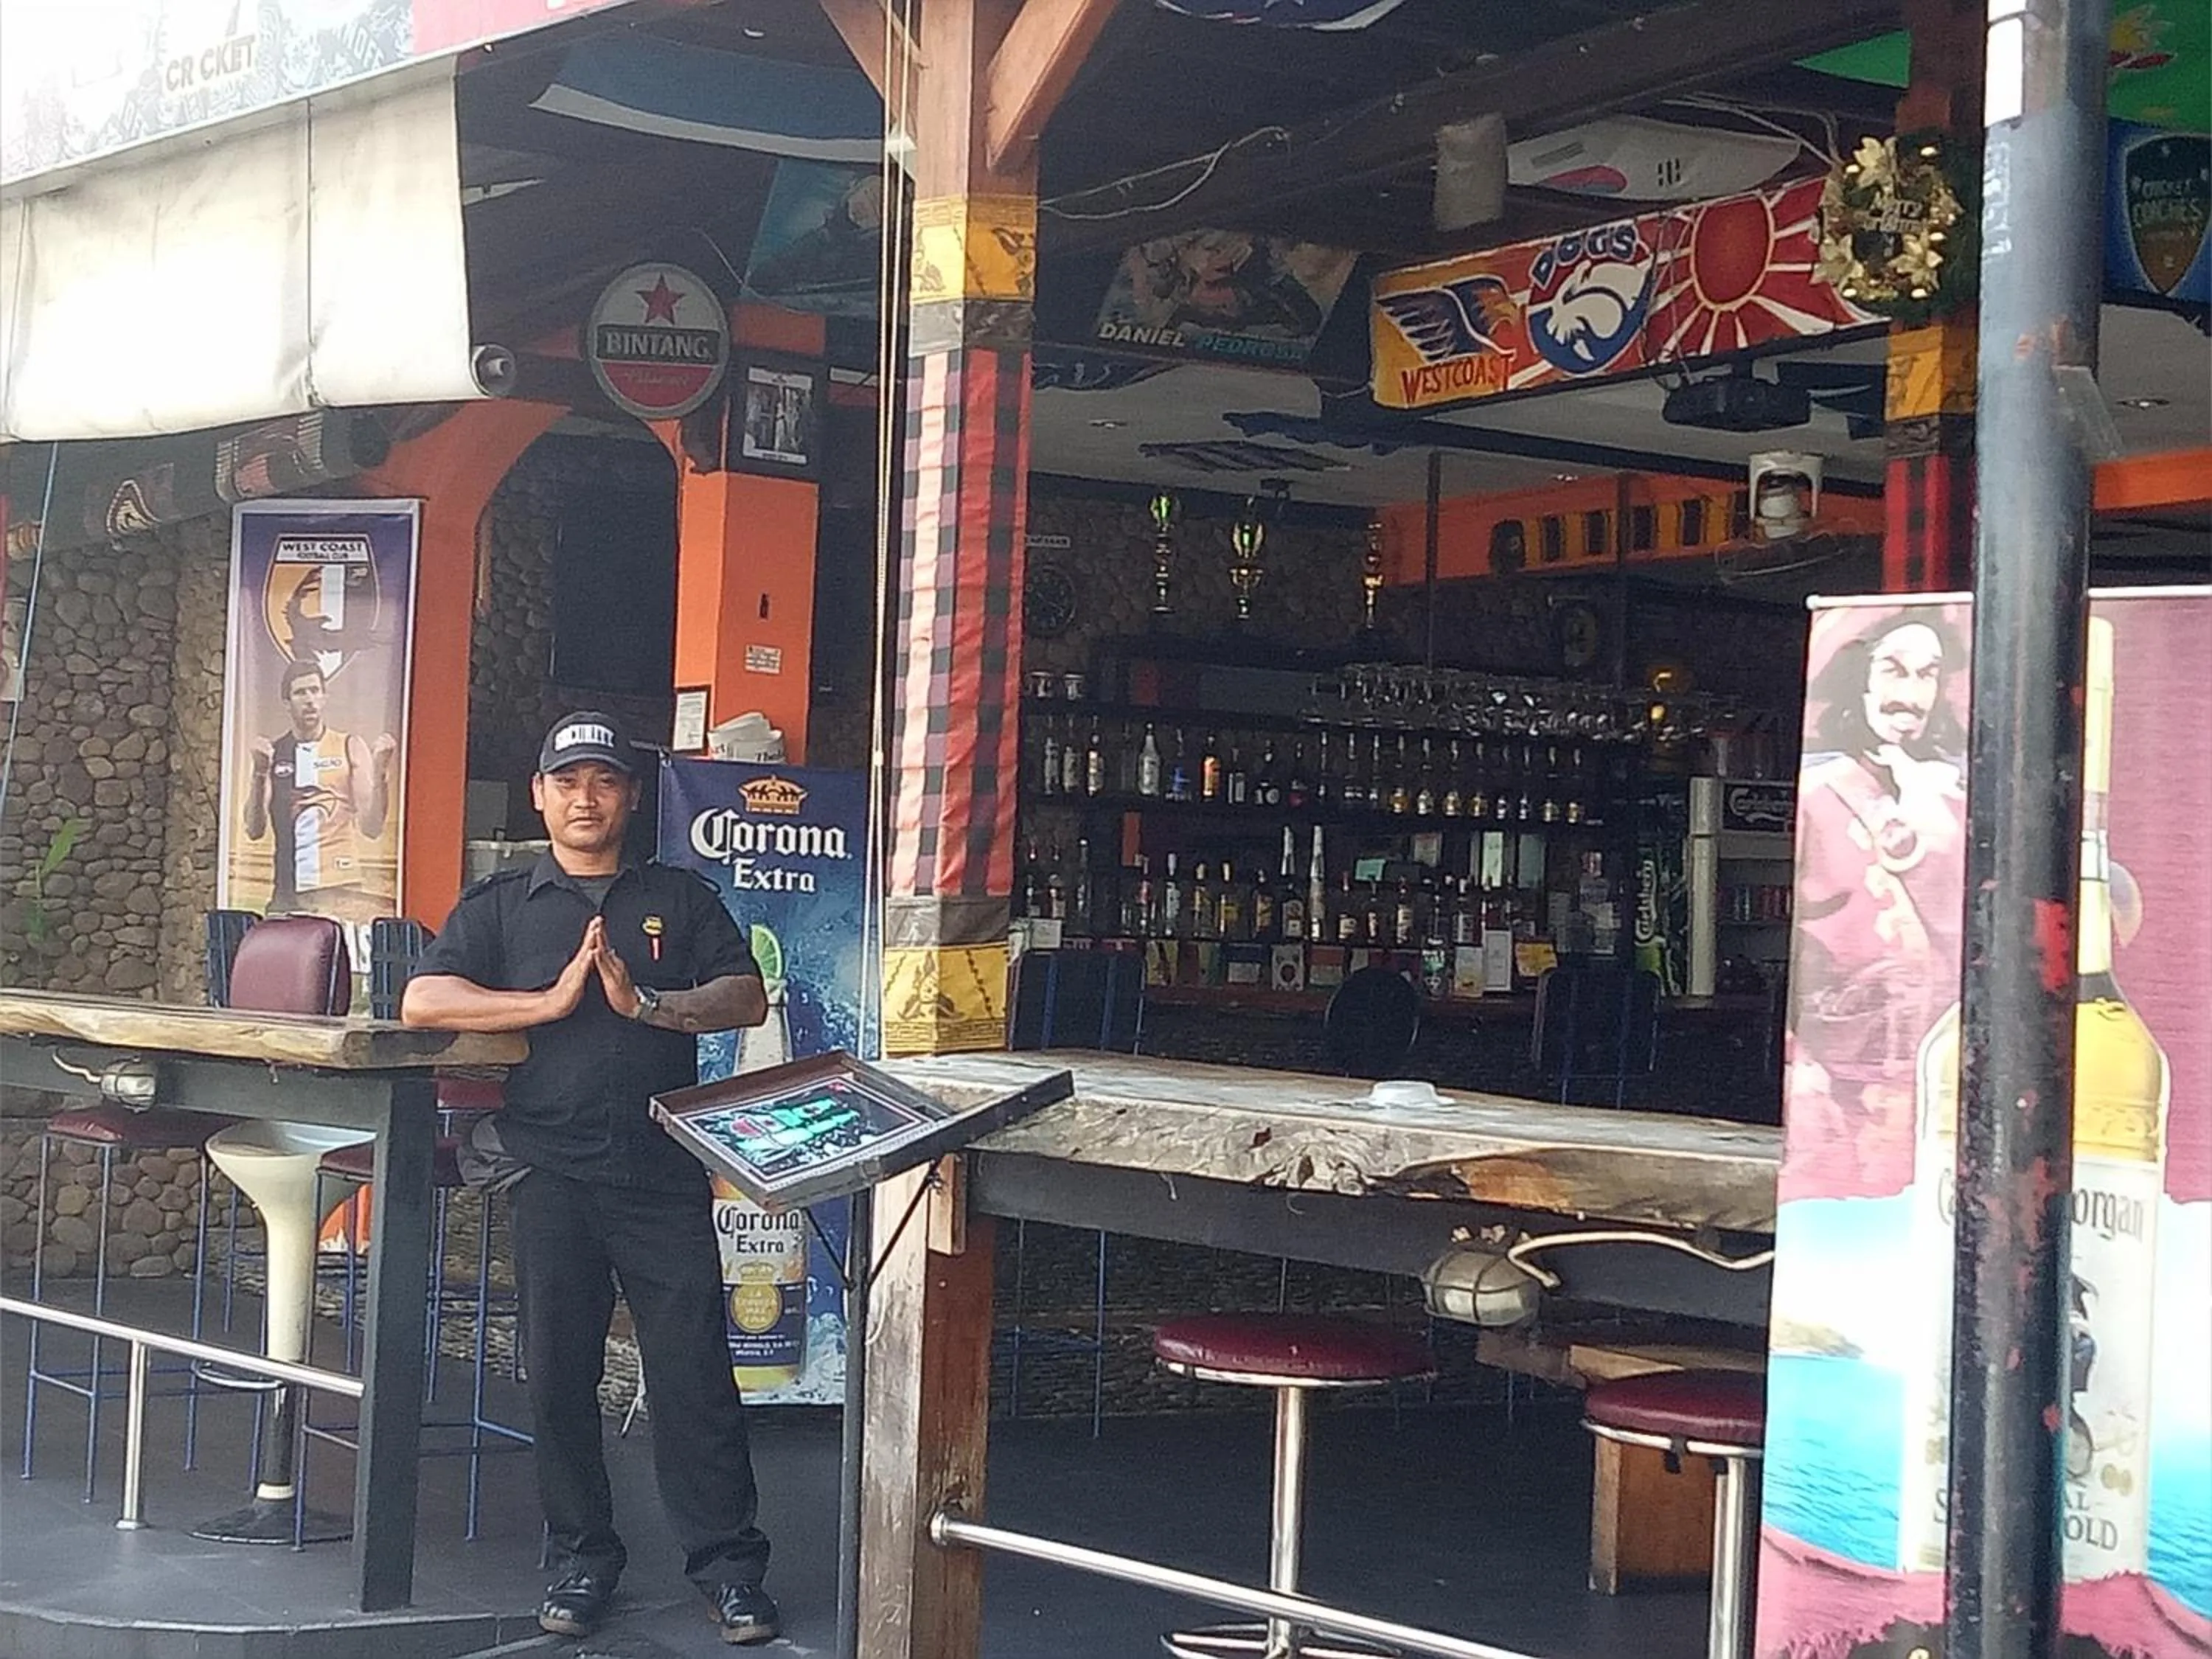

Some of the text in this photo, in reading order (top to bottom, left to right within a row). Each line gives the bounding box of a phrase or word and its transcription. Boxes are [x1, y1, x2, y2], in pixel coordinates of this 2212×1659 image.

[1530, 221, 1638, 289] DOGS
[606, 331, 710, 359] BINTANG
[1096, 322, 1186, 348] DANIEL
[1401, 354, 1512, 404] WESTCOAST
[283, 542, 362, 552] WEST COAST
[690, 808, 849, 866] Corona
[732, 857, 815, 892] Extra
[717, 1205, 799, 1239] Corona
[2070, 1186, 2145, 1242] organ
[737, 1234, 785, 1253] Extra
[2063, 1514, 2119, 1552] OLD
